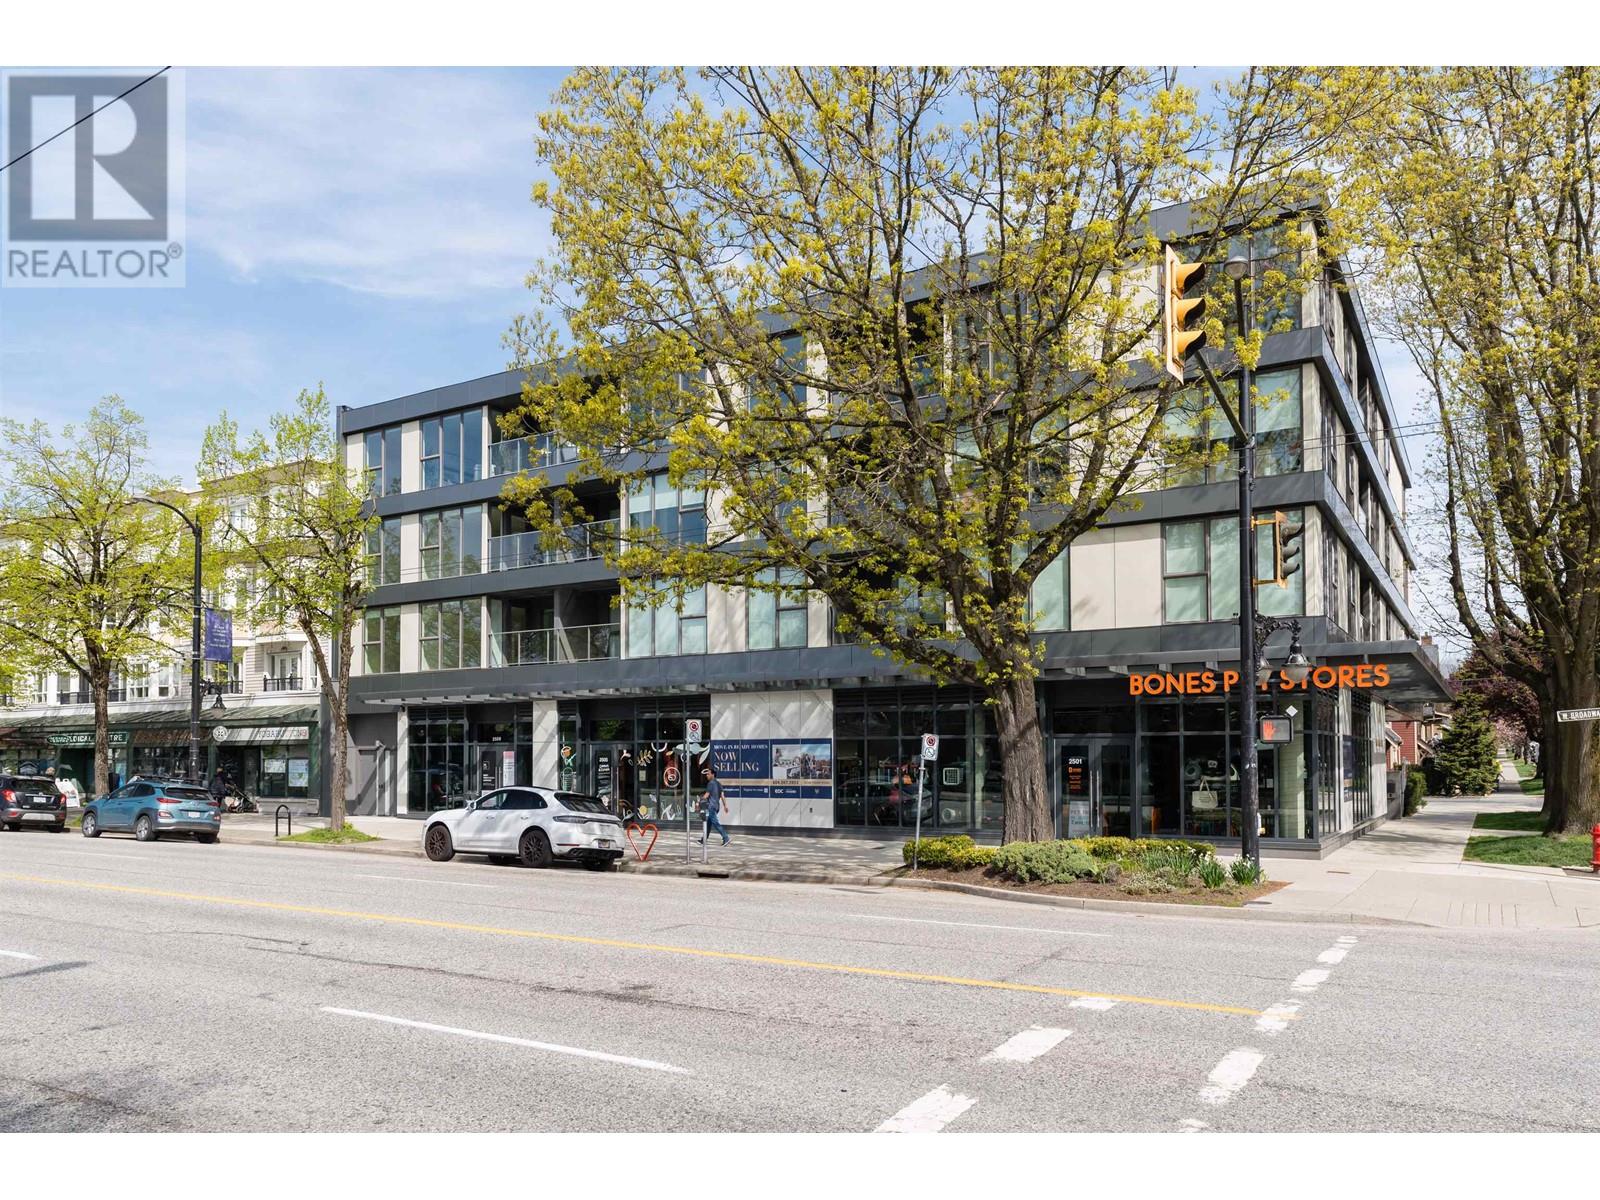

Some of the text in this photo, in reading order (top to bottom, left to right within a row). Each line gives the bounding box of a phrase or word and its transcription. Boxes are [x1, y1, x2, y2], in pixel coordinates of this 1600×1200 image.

[1129, 672, 1217, 696] BONES
[1280, 664, 1391, 690] STORES
[714, 751, 737, 761] NOW
[713, 762, 759, 772] SELLING
